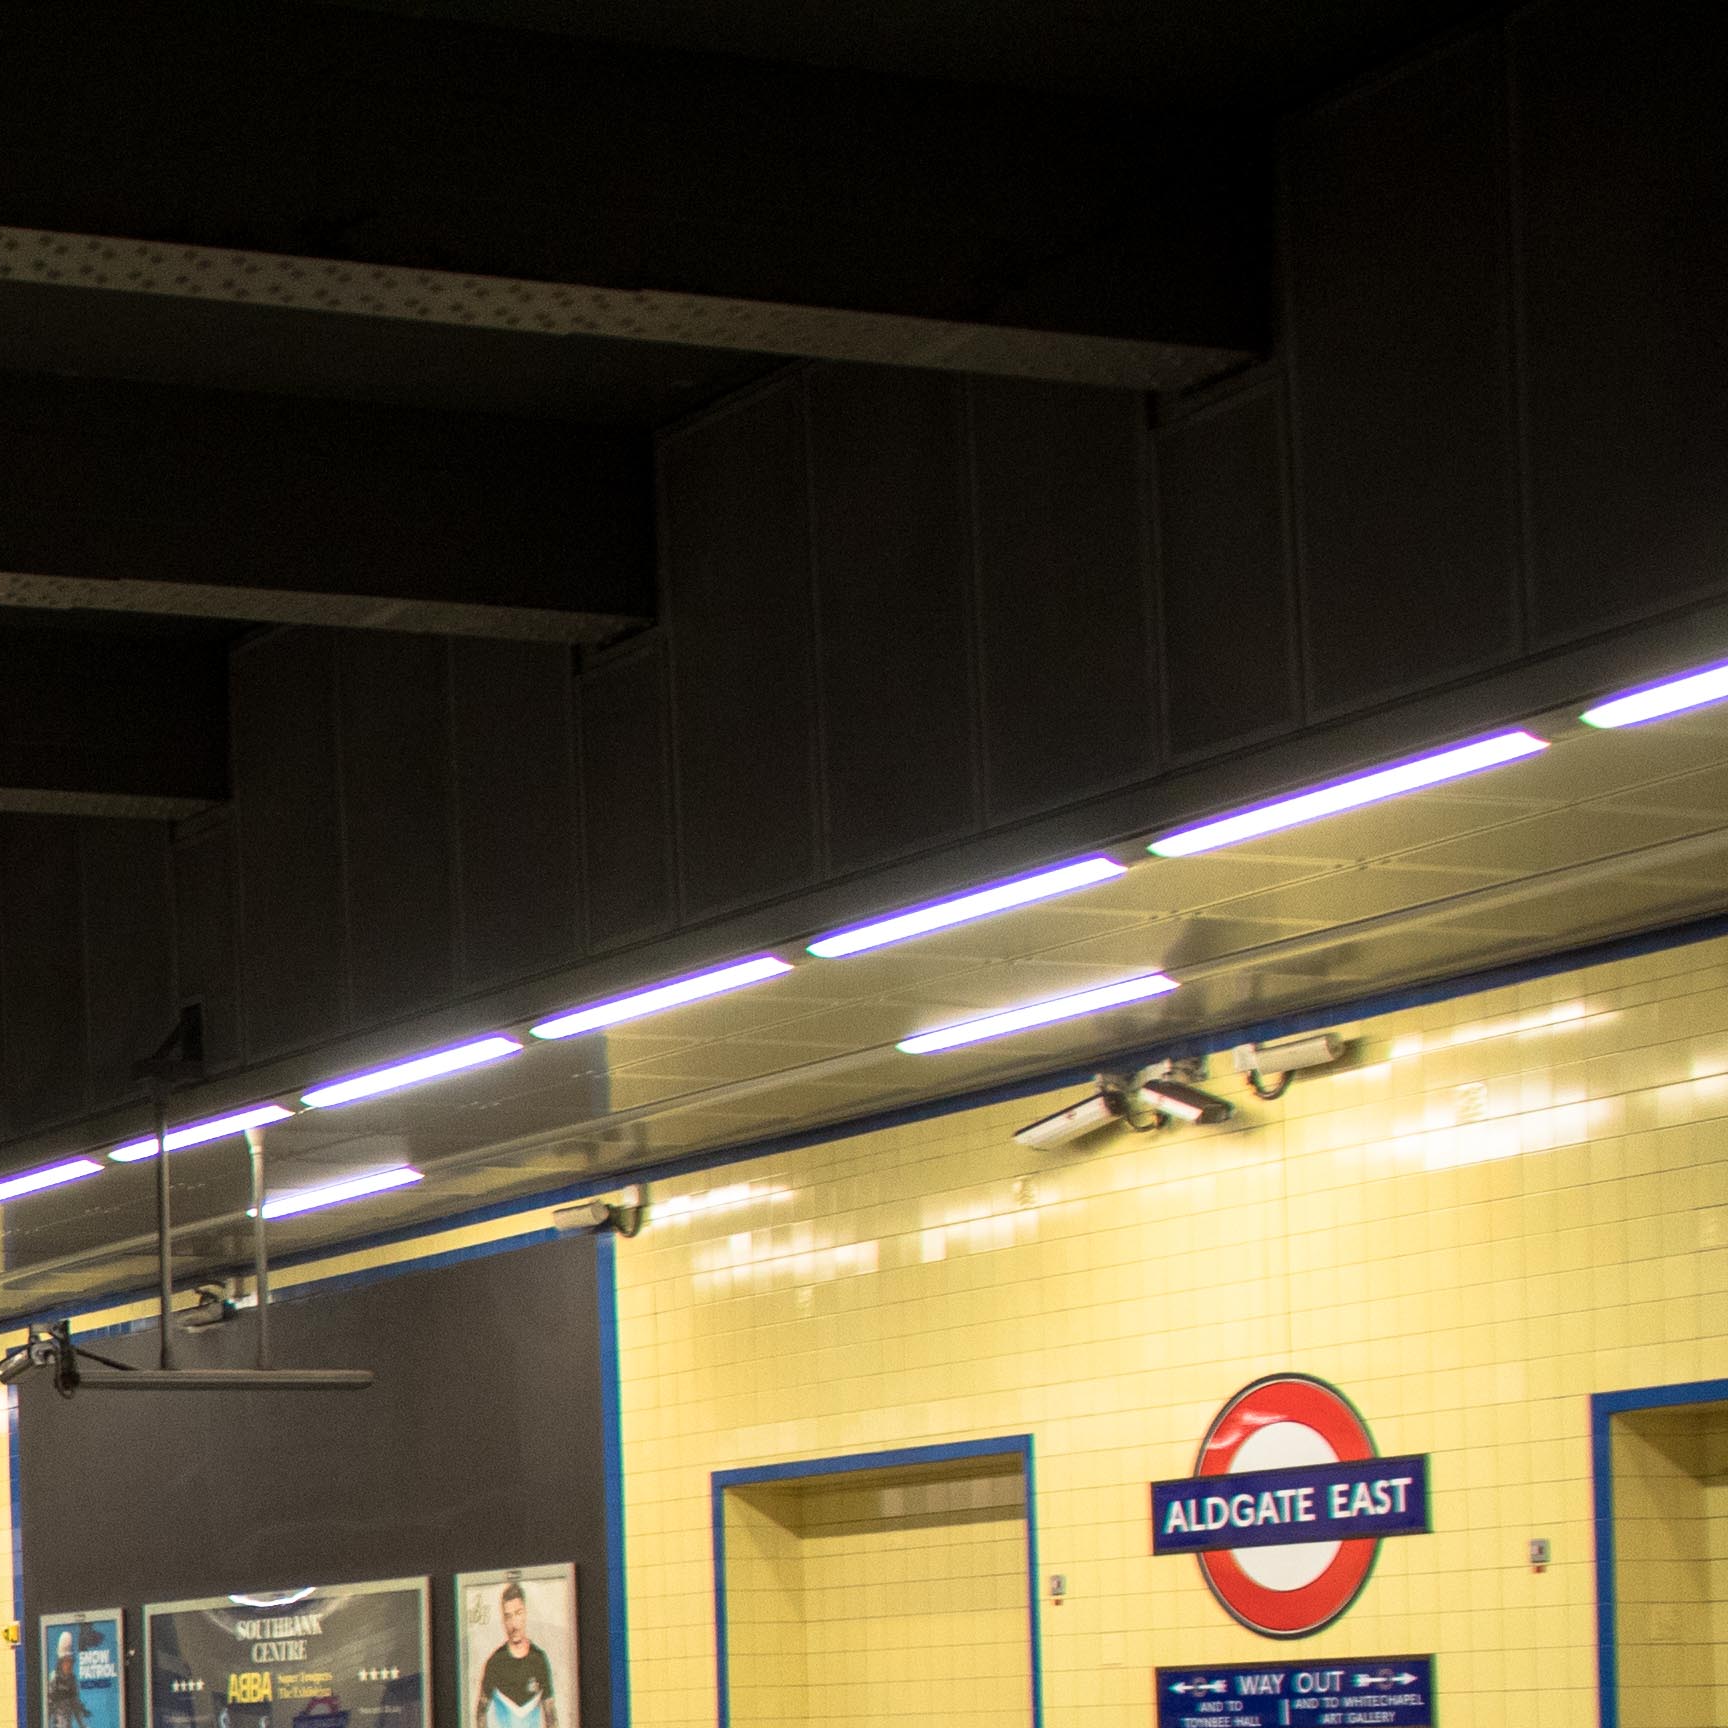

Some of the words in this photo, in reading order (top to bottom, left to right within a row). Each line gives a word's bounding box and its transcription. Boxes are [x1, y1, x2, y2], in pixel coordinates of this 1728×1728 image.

[1161, 1486, 1316, 1535] ALDGATE
[1327, 1476, 1413, 1520] EAST
[236, 1613, 323, 1641] SOUTHBANK
[79, 1649, 110, 1665] SNOW
[252, 1639, 307, 1664] CENTRE
[79, 1663, 117, 1679] PATROL
[1237, 1672, 1286, 1696] WAY
[1295, 1669, 1345, 1694] OUT
[1199, 1700, 1226, 1713] AND
[1228, 1700, 1243, 1712] TO
[1294, 1696, 1319, 1710] AND
[1323, 1696, 1340, 1709] TO
[1343, 1693, 1425, 1708] WHITECHAPEL
[1181, 1716, 1231, 1728] TOYNBEE
[1234, 1715, 1262, 1728] HALL
[1321, 1713, 1344, 1725] ART
[1347, 1710, 1396, 1724] GALLERY
